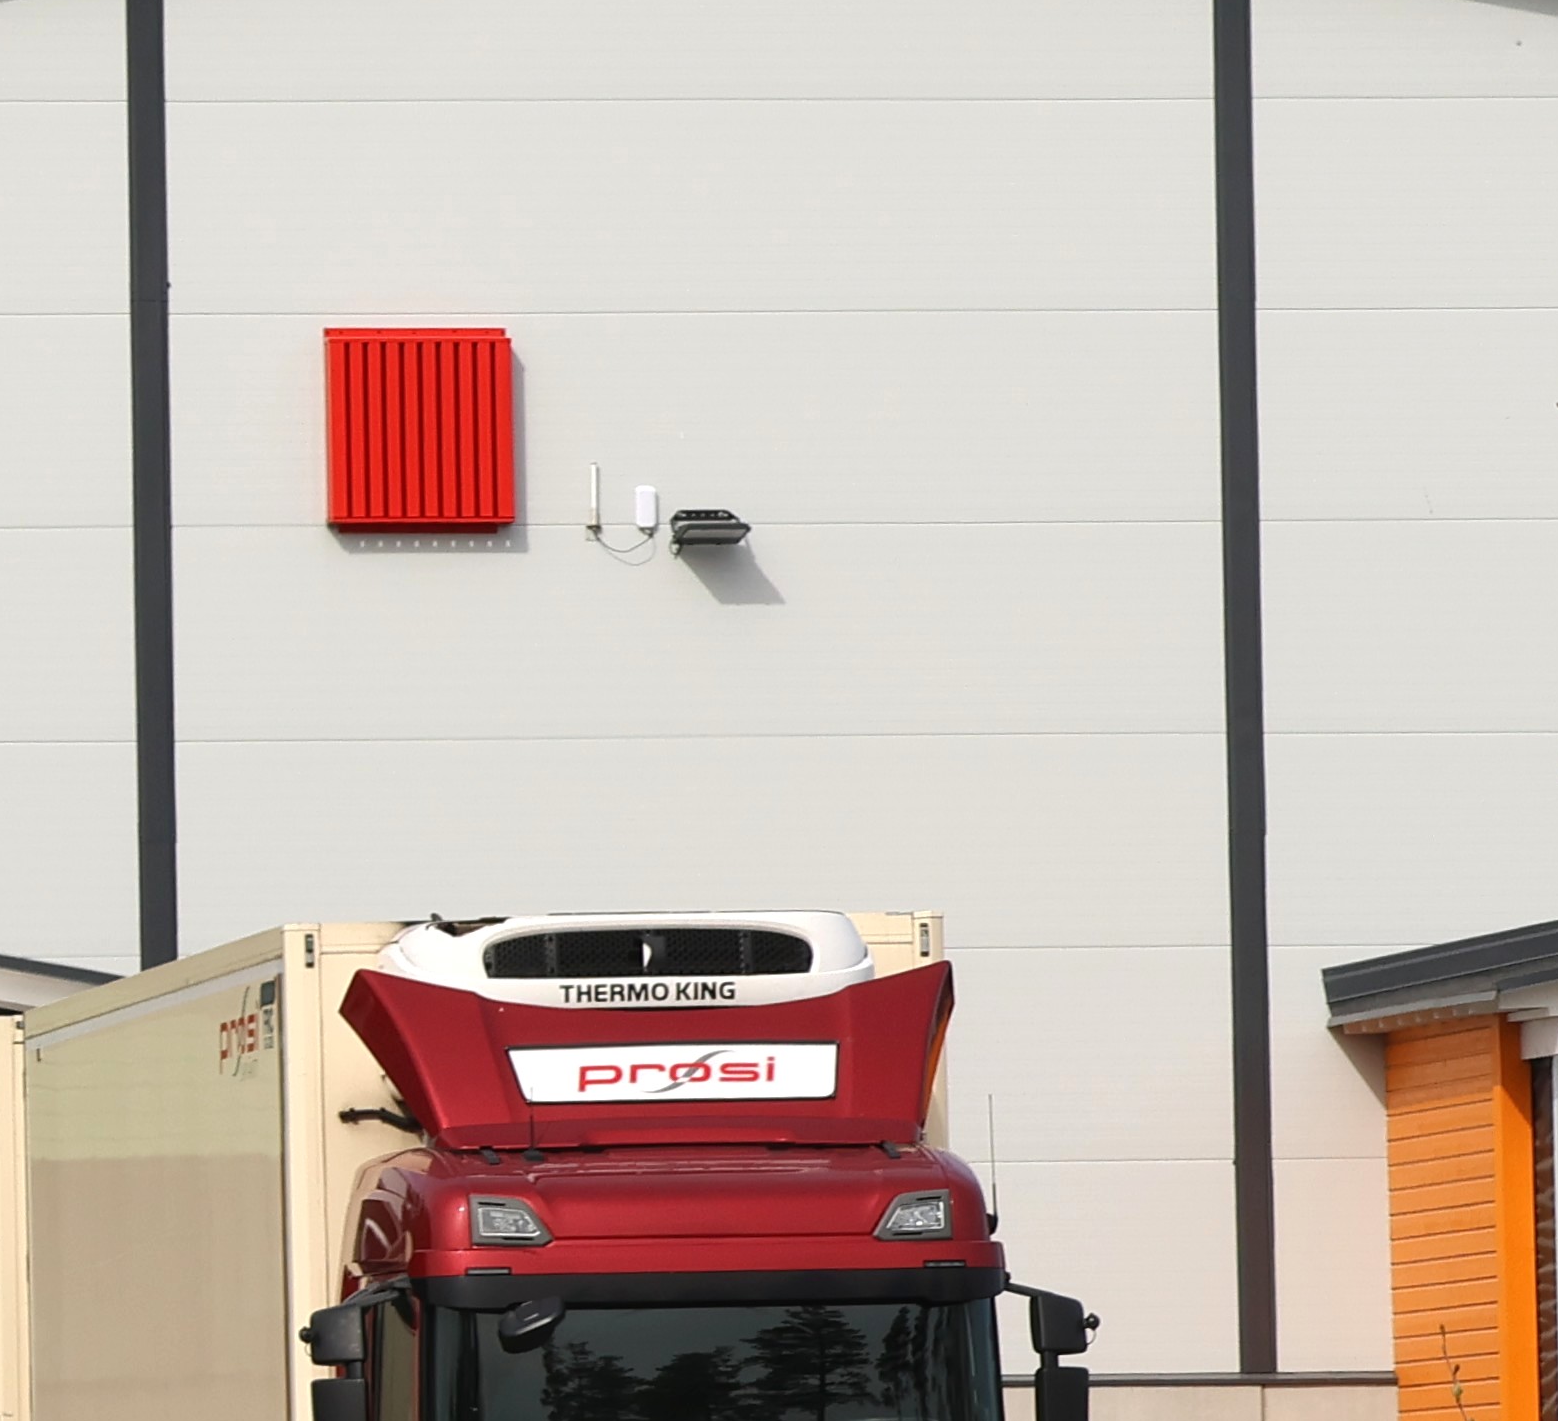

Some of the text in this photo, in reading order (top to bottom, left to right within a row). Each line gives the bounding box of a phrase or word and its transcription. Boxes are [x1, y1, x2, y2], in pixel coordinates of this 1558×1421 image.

[559, 982, 736, 1003] THERMO KING
[577, 1055, 776, 1093] prosi
